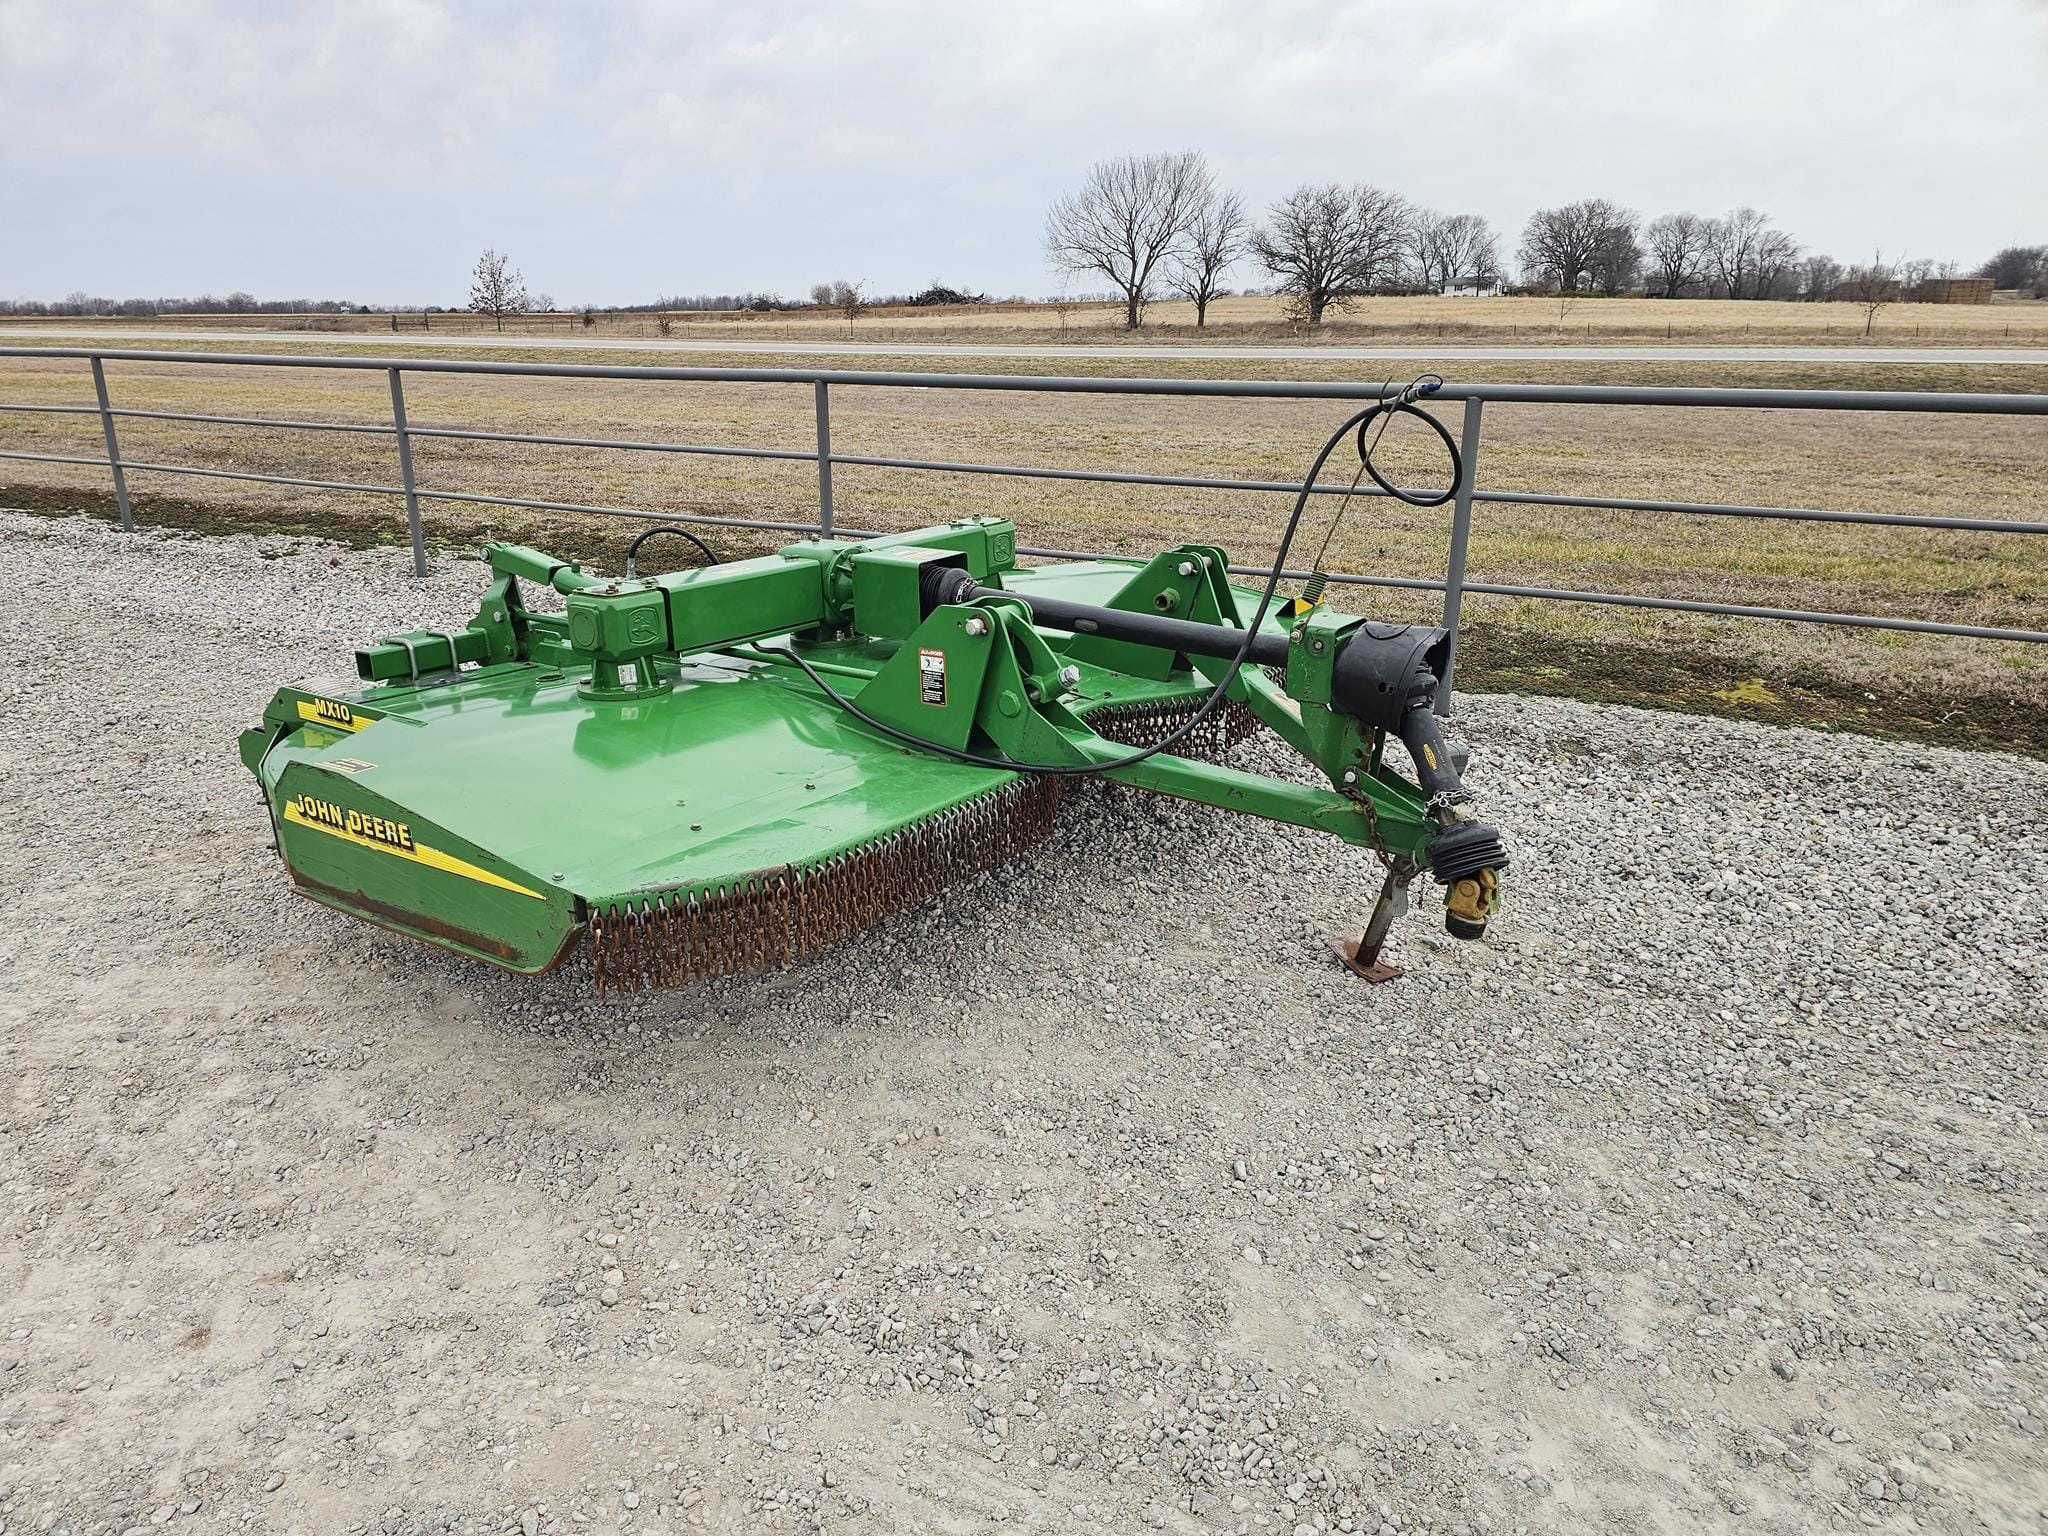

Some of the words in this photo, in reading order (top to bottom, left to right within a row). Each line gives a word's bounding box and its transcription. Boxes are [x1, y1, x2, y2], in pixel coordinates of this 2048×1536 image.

[314, 698, 351, 722] MX10
[295, 793, 344, 829] JOHN
[348, 808, 413, 848] DEERE
